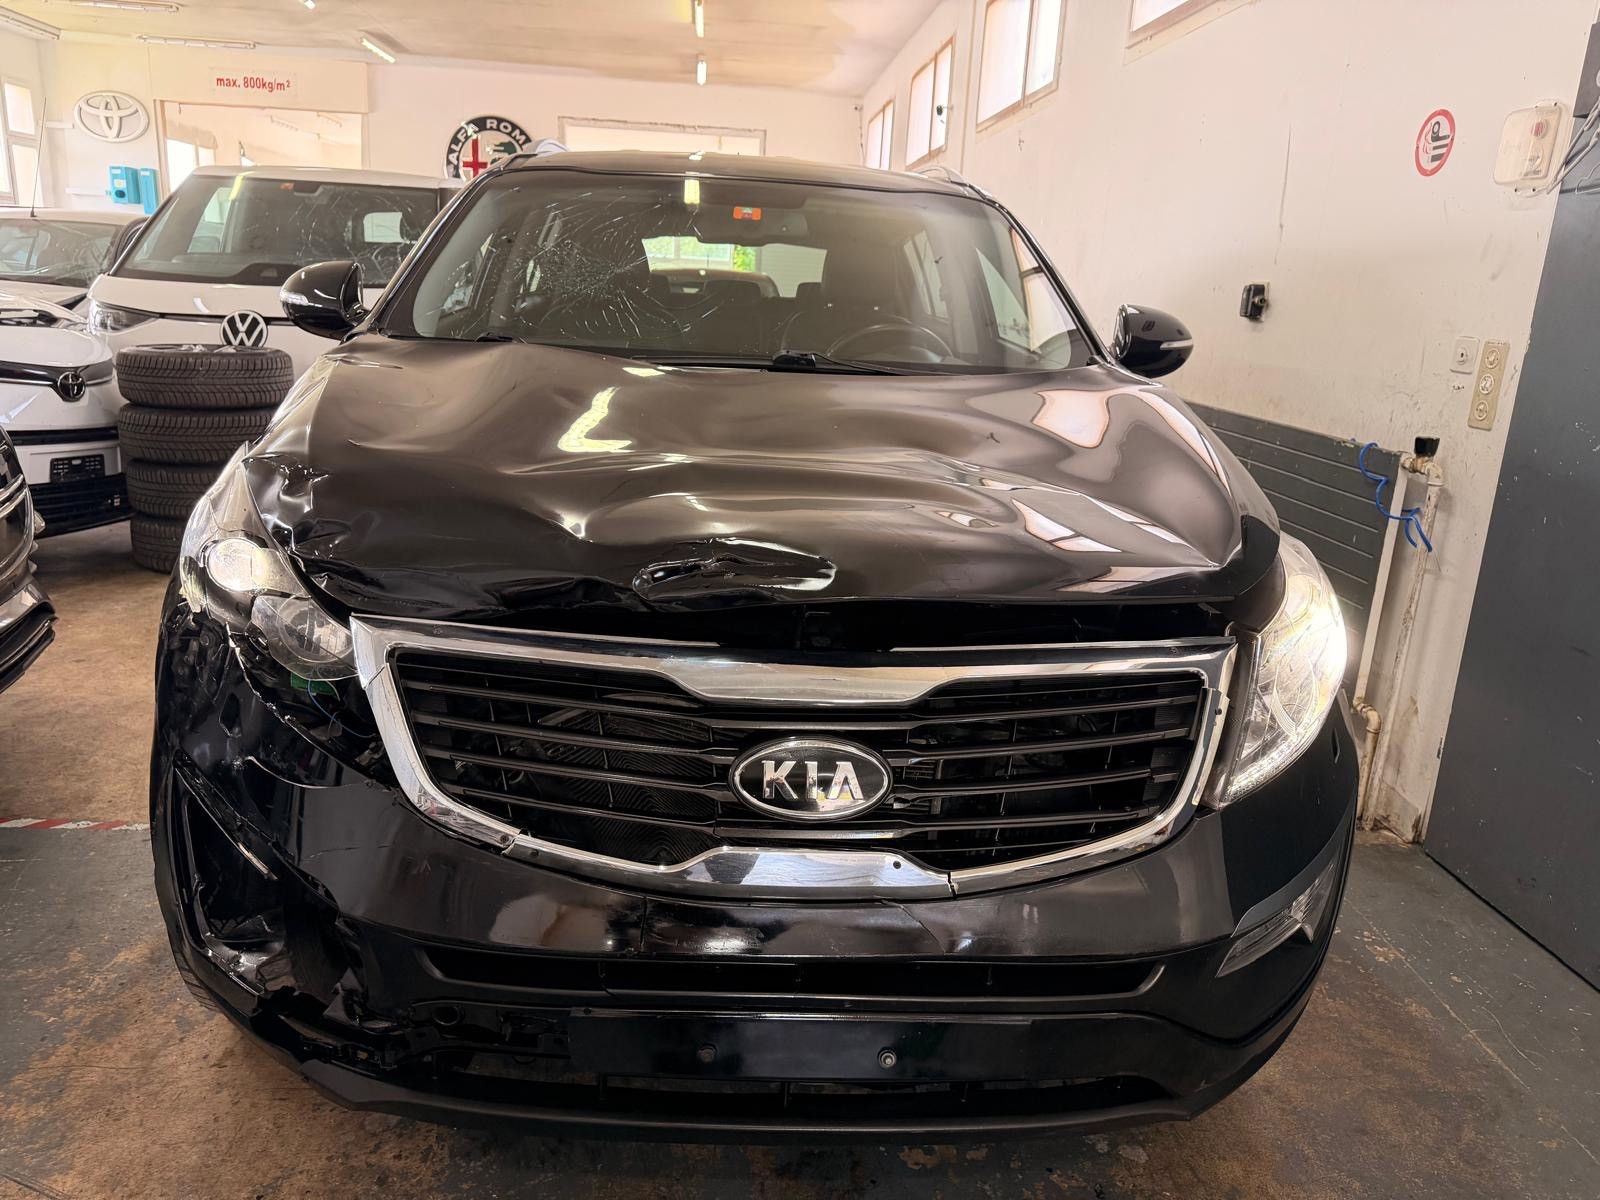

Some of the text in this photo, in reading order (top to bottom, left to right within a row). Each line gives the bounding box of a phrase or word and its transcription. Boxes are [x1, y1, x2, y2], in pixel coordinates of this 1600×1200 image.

[216, 77, 240, 88] max.
[448, 118, 527, 166] ALFA ROM
[761, 760, 864, 800] KIA
